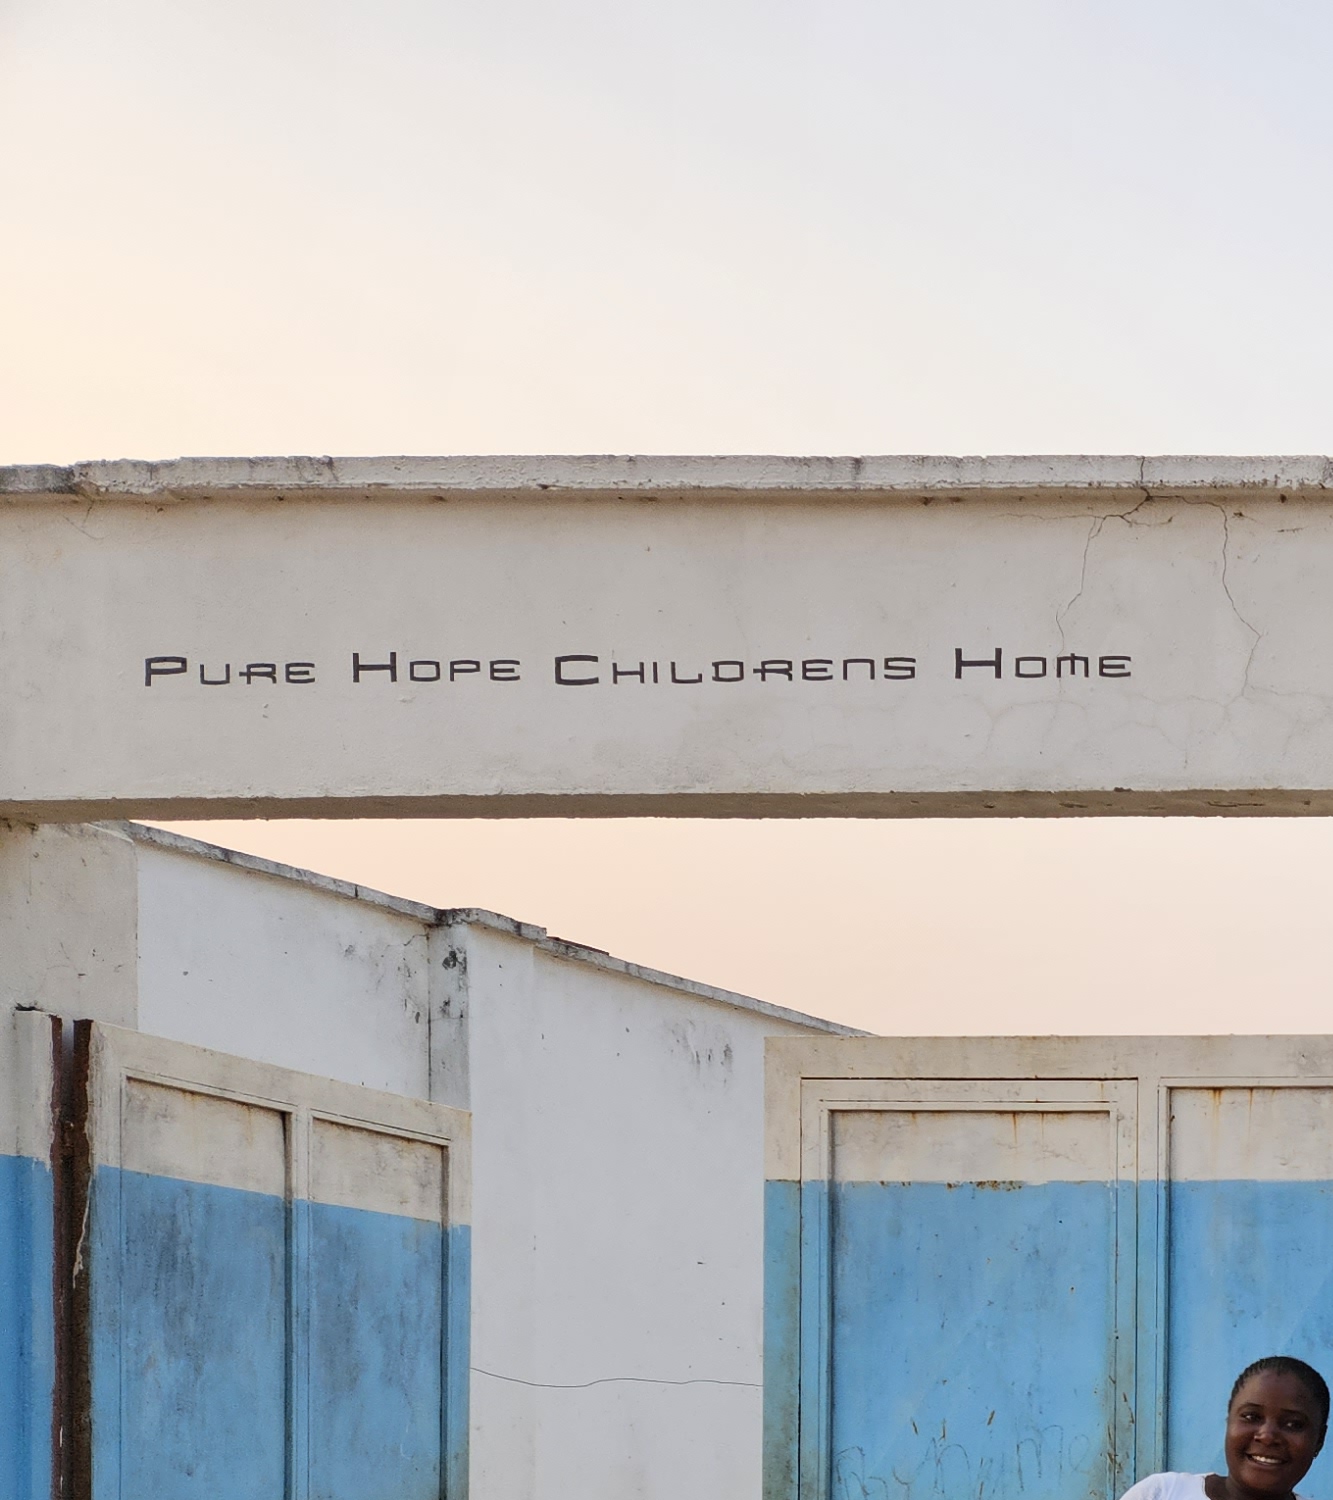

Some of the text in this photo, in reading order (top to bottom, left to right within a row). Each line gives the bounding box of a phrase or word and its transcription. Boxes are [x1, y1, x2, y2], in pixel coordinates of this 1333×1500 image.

[144, 656, 316, 687] PURE
[352, 651, 521, 683] HOPE
[954, 647, 1132, 680] HOME
